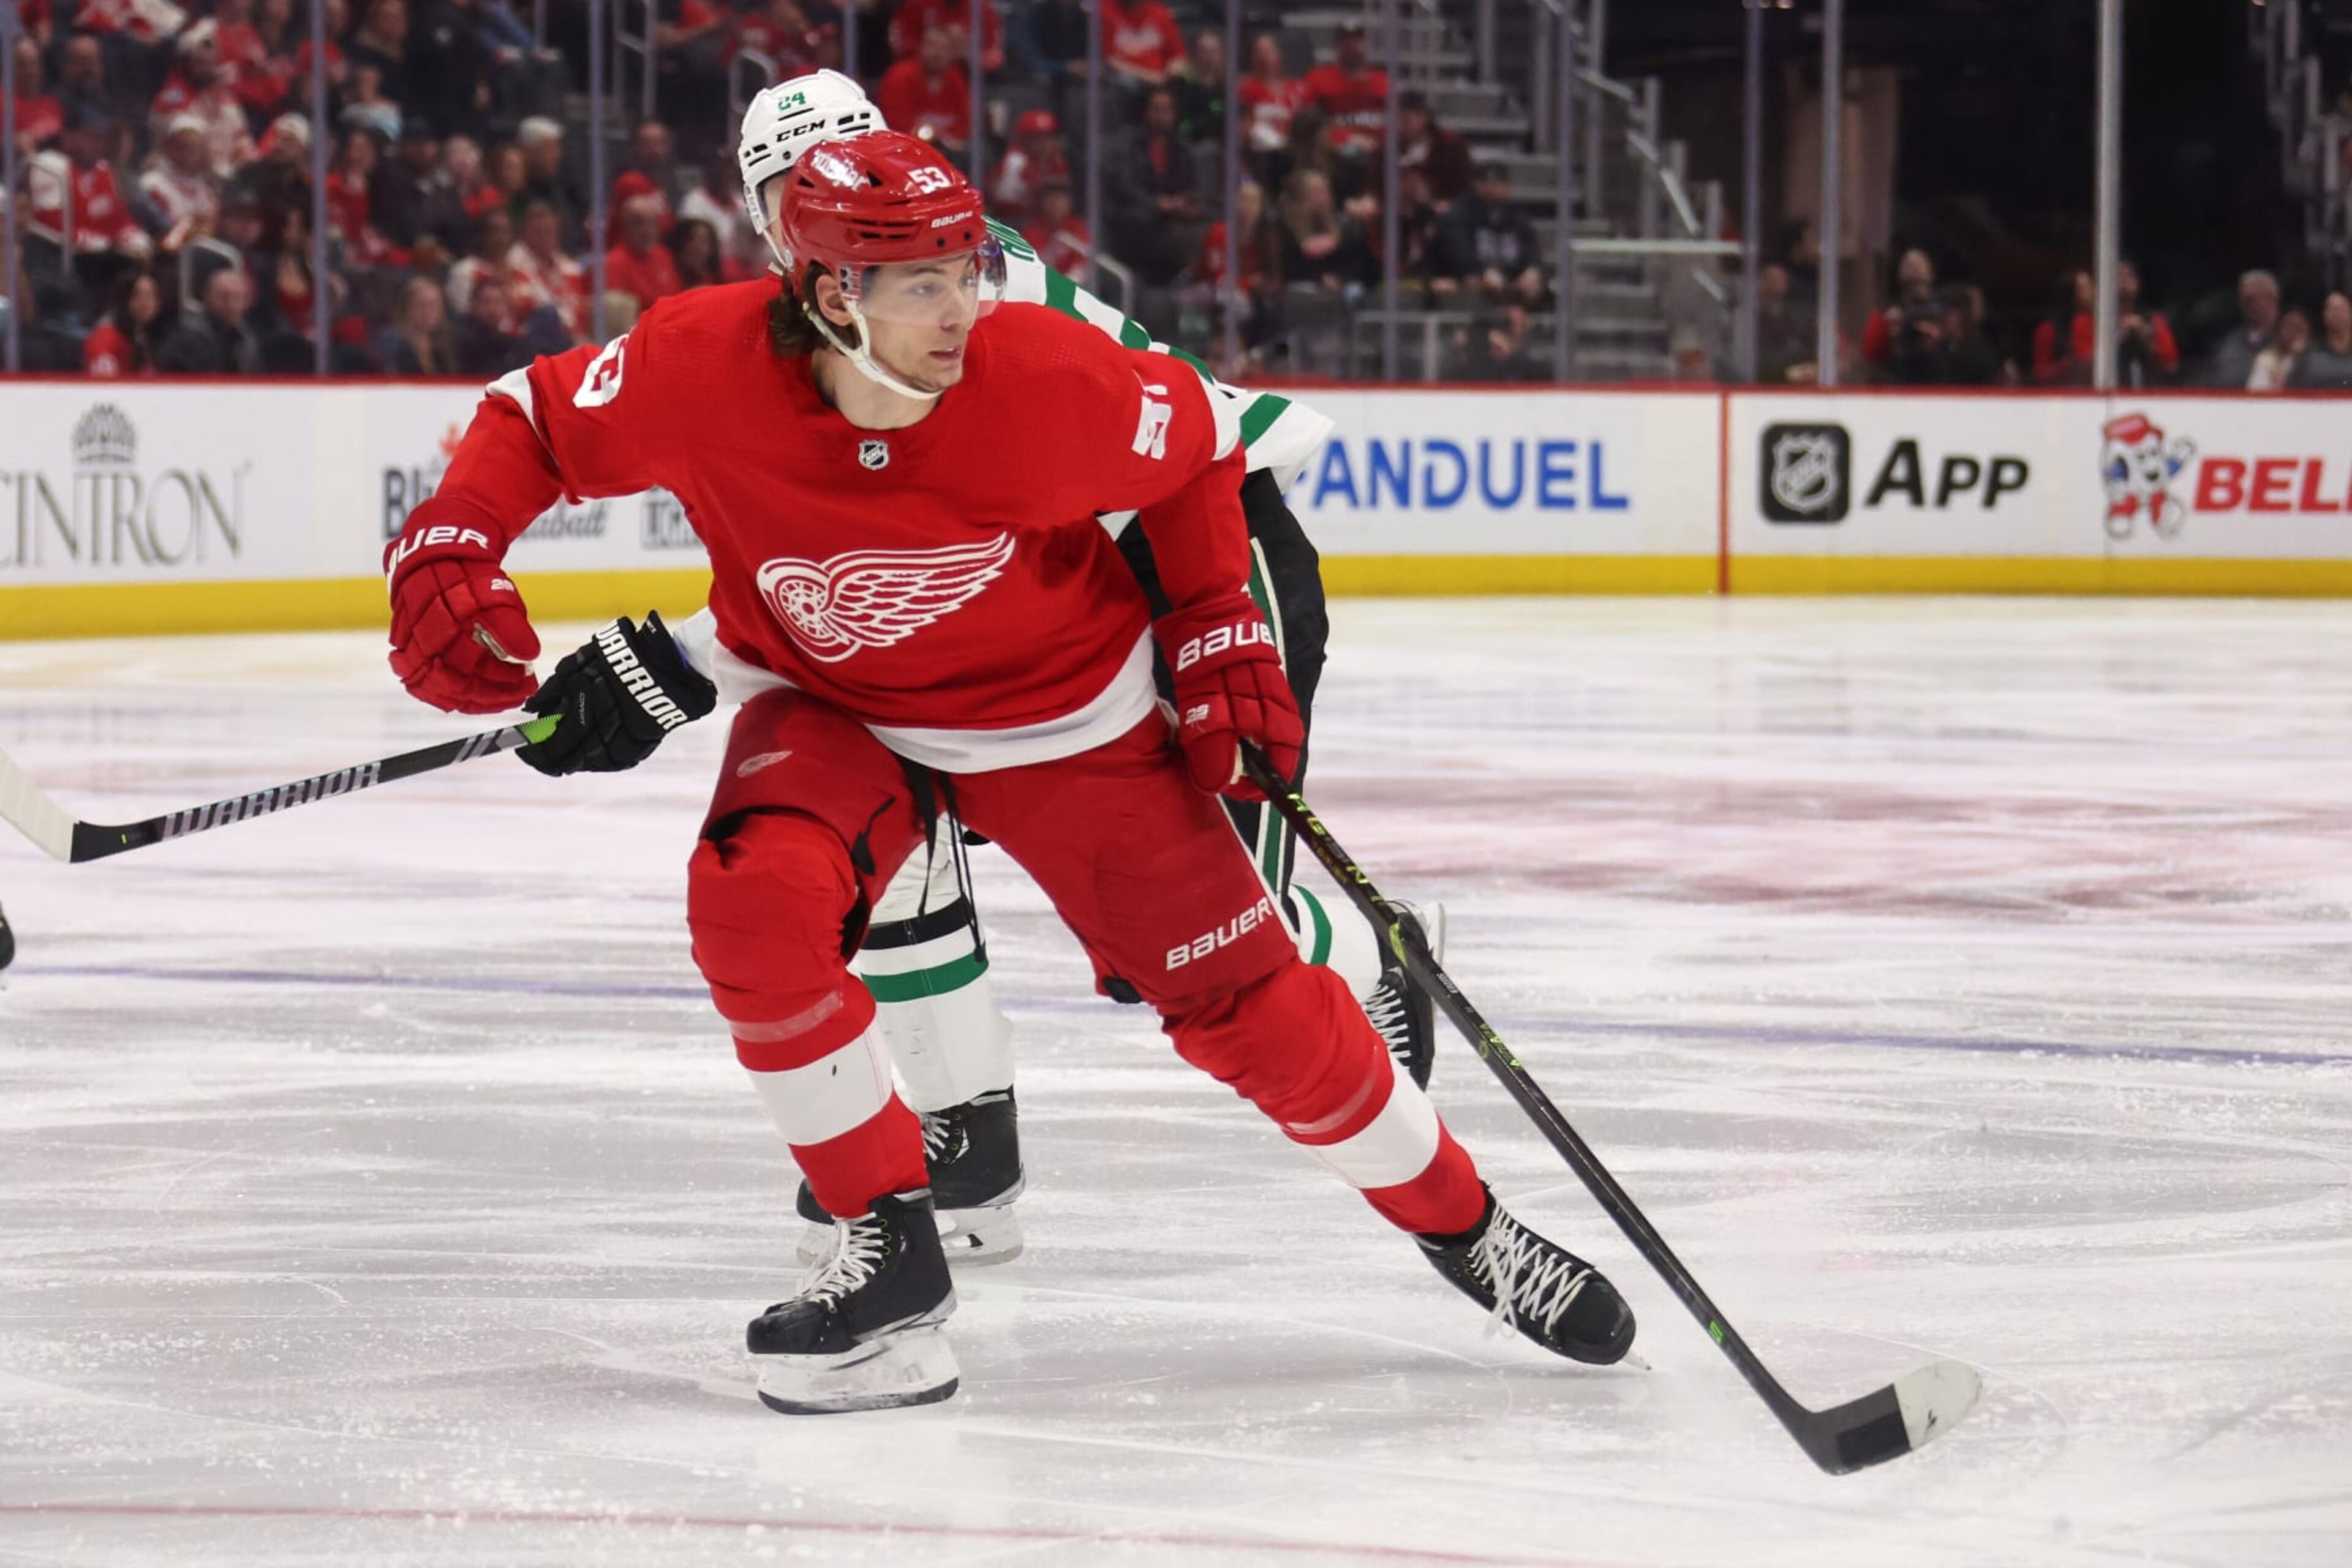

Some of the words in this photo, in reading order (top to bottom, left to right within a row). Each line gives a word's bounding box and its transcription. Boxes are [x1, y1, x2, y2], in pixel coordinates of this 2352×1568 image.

[777, 92, 806, 111] 24
[776, 119, 826, 143] CCM
[908, 167, 952, 194] 53
[1283, 439, 1629, 510] ANDUEL
[2193, 456, 2352, 514] BEL
[0, 467, 244, 566] INTRON
[1166, 896, 1273, 971] BAUER
